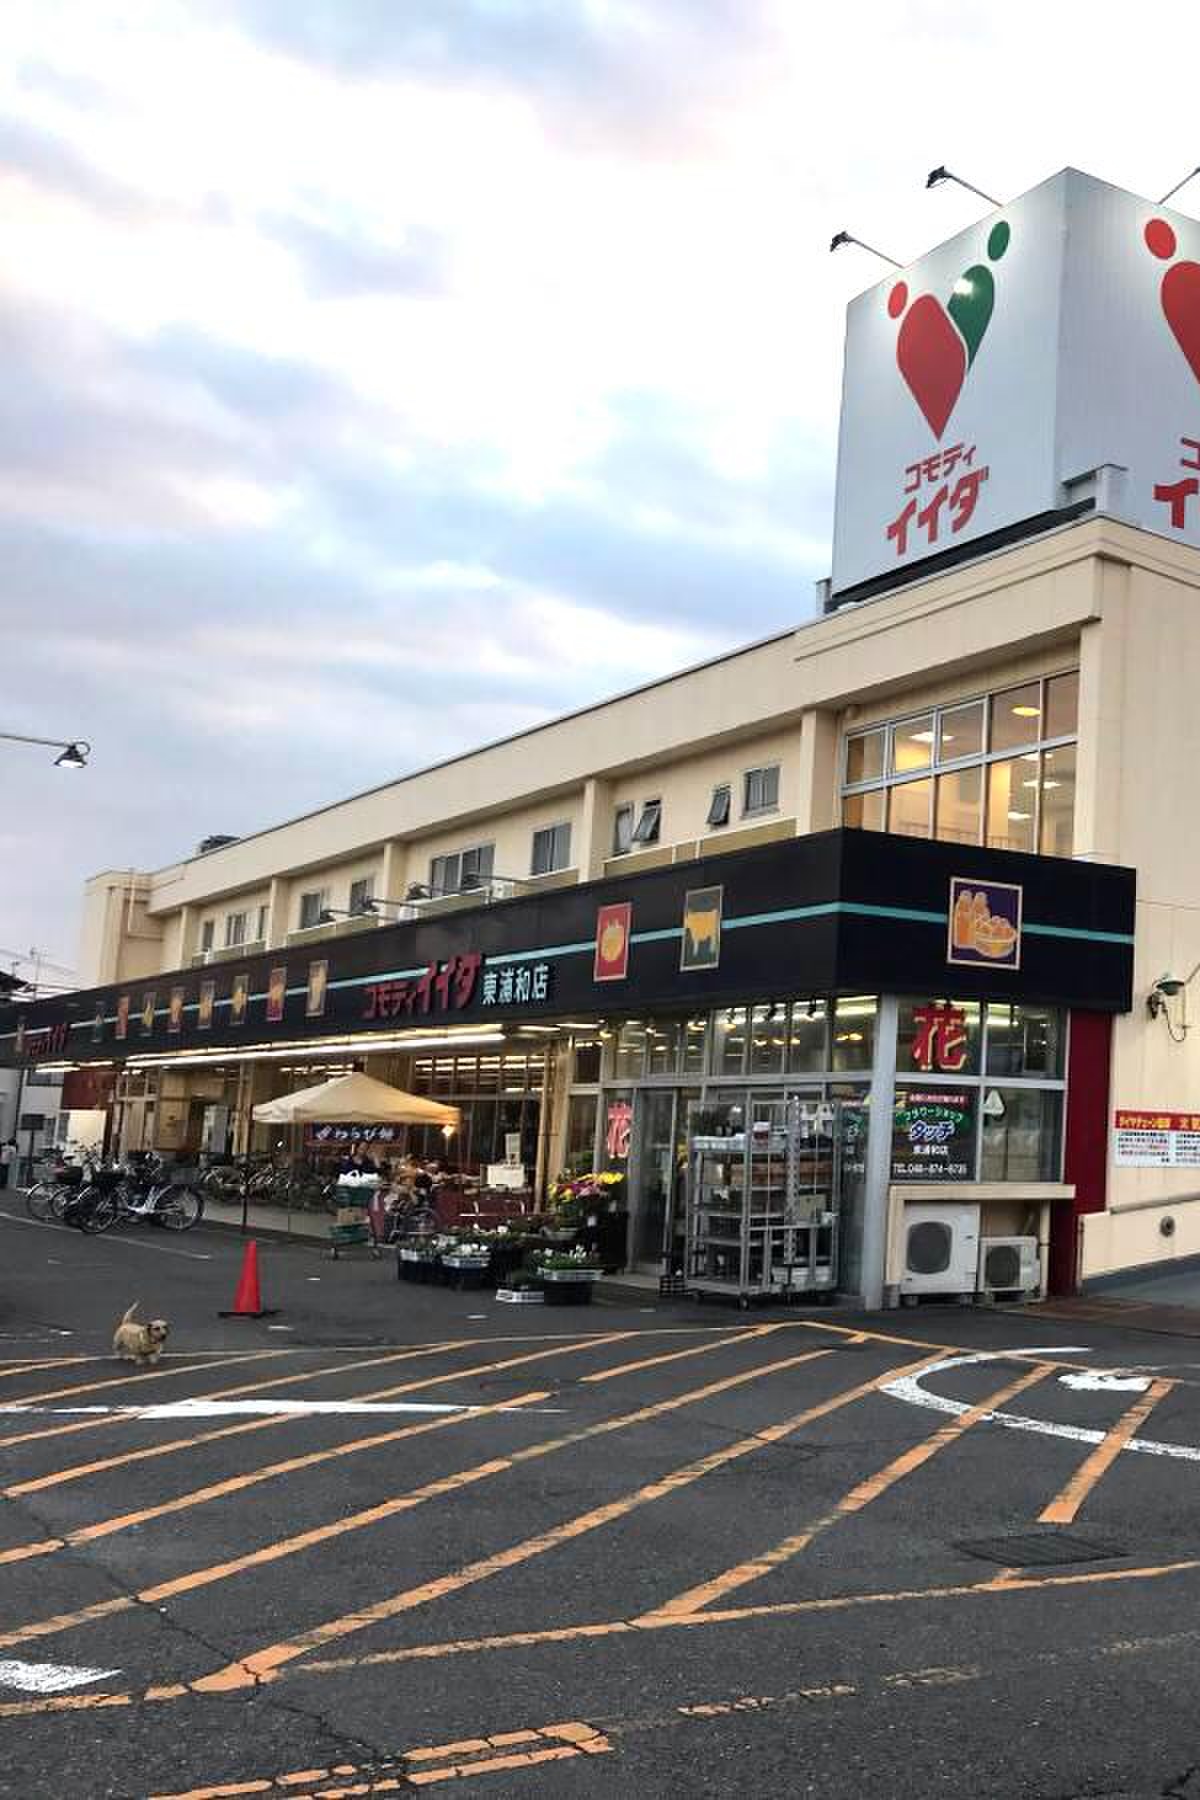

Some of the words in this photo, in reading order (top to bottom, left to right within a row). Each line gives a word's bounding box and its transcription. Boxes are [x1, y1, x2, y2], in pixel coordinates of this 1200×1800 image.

[905, 439, 977, 494] コモディ
[886, 466, 989, 555] イイダ
[482, 963, 549, 1006] 東浦和店
[911, 1003, 969, 1072] 花
[607, 1100, 634, 1159] 花
[909, 1119, 956, 1143] タッチ
